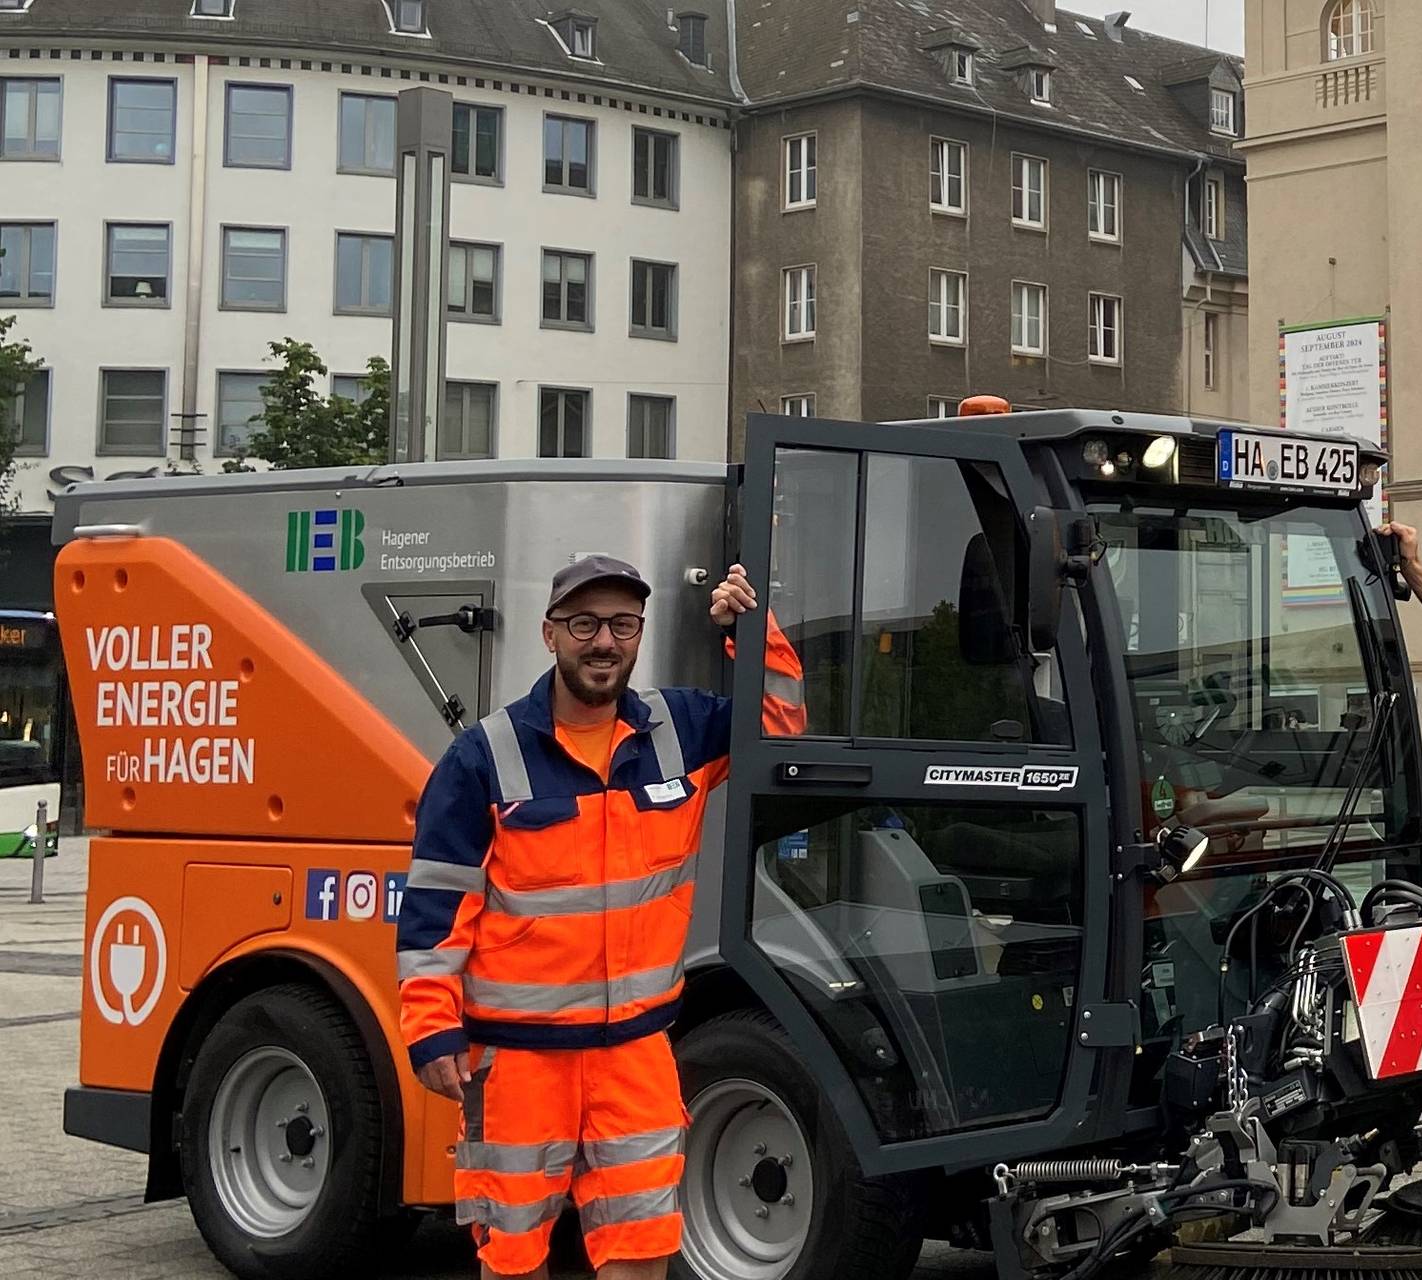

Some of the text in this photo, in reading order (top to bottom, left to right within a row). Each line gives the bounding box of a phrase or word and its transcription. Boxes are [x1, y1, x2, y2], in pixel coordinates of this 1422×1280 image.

[1301, 341, 1345, 352] SEPTEMBER
[1316, 331, 1346, 342] AUGUST
[1222, 438, 1355, 484] D HA EB 425
[382, 530, 431, 549] Hagener
[380, 552, 496, 573] Entsorgungsbetrieb
[86, 623, 213, 671] VOLLER
[96, 680, 239, 727] ENERGIE
[106, 737, 255, 784] FÜR HAGEN
[929, 768, 1021, 783] CITYMASTER
